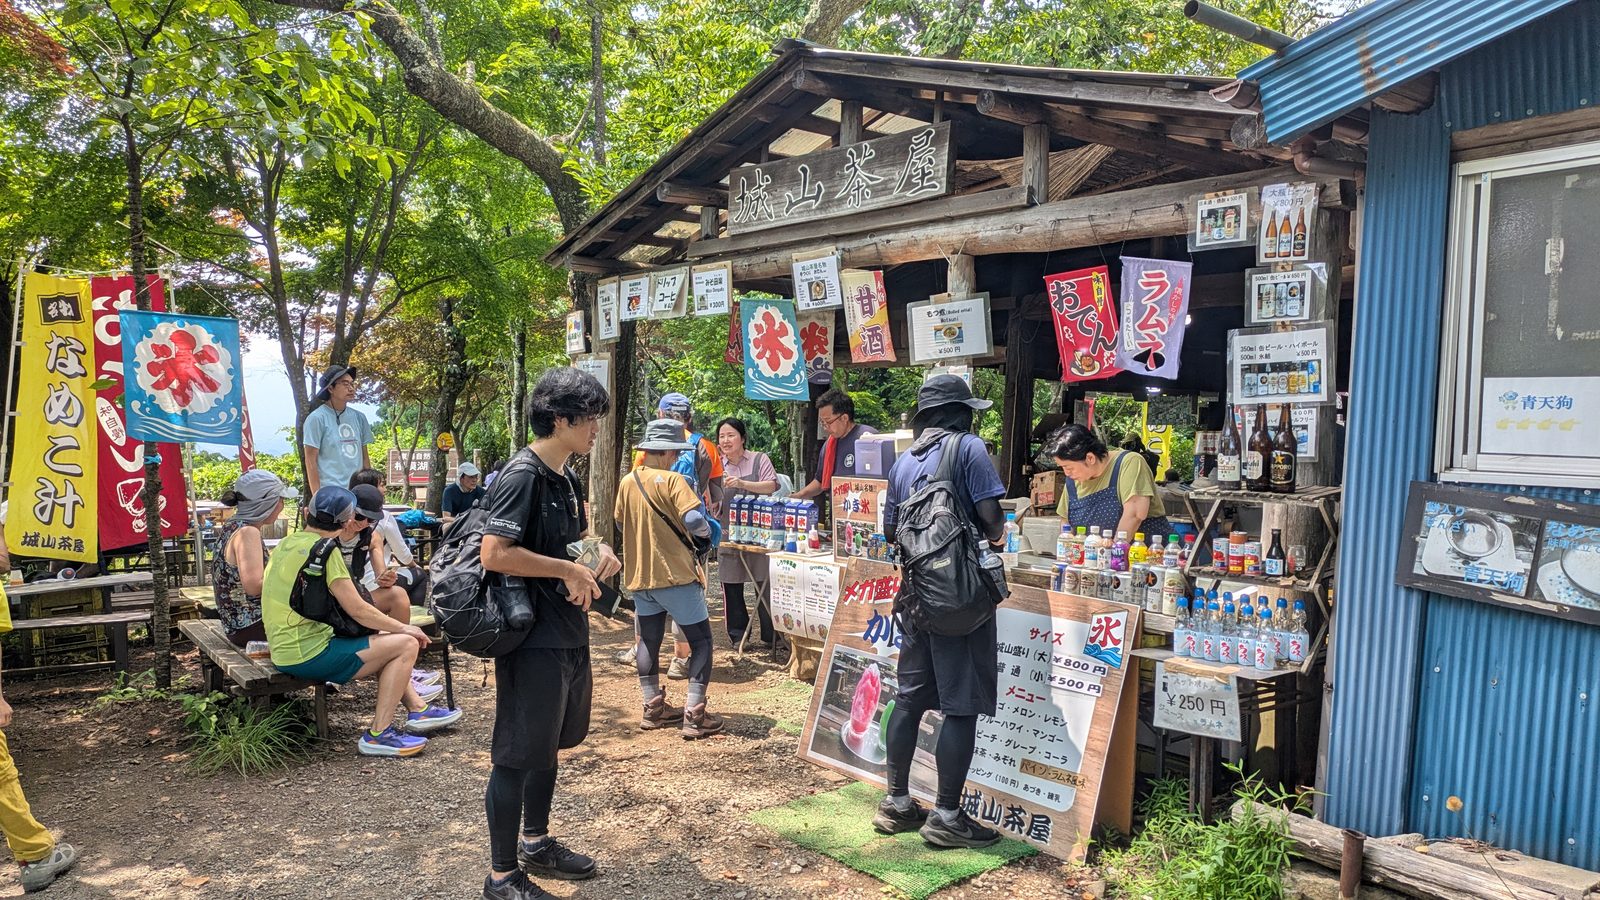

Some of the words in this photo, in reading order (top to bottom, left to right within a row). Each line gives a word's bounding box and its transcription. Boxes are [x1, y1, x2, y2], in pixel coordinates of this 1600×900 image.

[734, 128, 940, 223] 城山茶屋
[855, 284, 886, 356] 甘酒
[1050, 280, 1118, 355] おでん
[753, 311, 793, 372] 氷
[146, 329, 221, 408] 氷
[1520, 395, 1574, 411] 青天狗
[33, 330, 88, 528] なめこ汁
[843, 498, 870, 514] かき氷
[490, 520, 521, 531] Honda
[20, 531, 85, 554] 城山茶屋
[842, 575, 900, 604] メガ盛り
[1463, 564, 1525, 593] 青天狗
[1029, 627, 1065, 646] サイズ
[1089, 616, 1122, 648] 氷
[1052, 656, 1107, 676] ¥800円
[1005, 685, 1046, 703] メニュー
[1047, 674, 1101, 694] ¥500円
[1166, 692, 1226, 716] ¥250円
[976, 729, 1068, 765] ピーチ・グレープ・コーラ
[961, 786, 1053, 845] 城山茶屋
